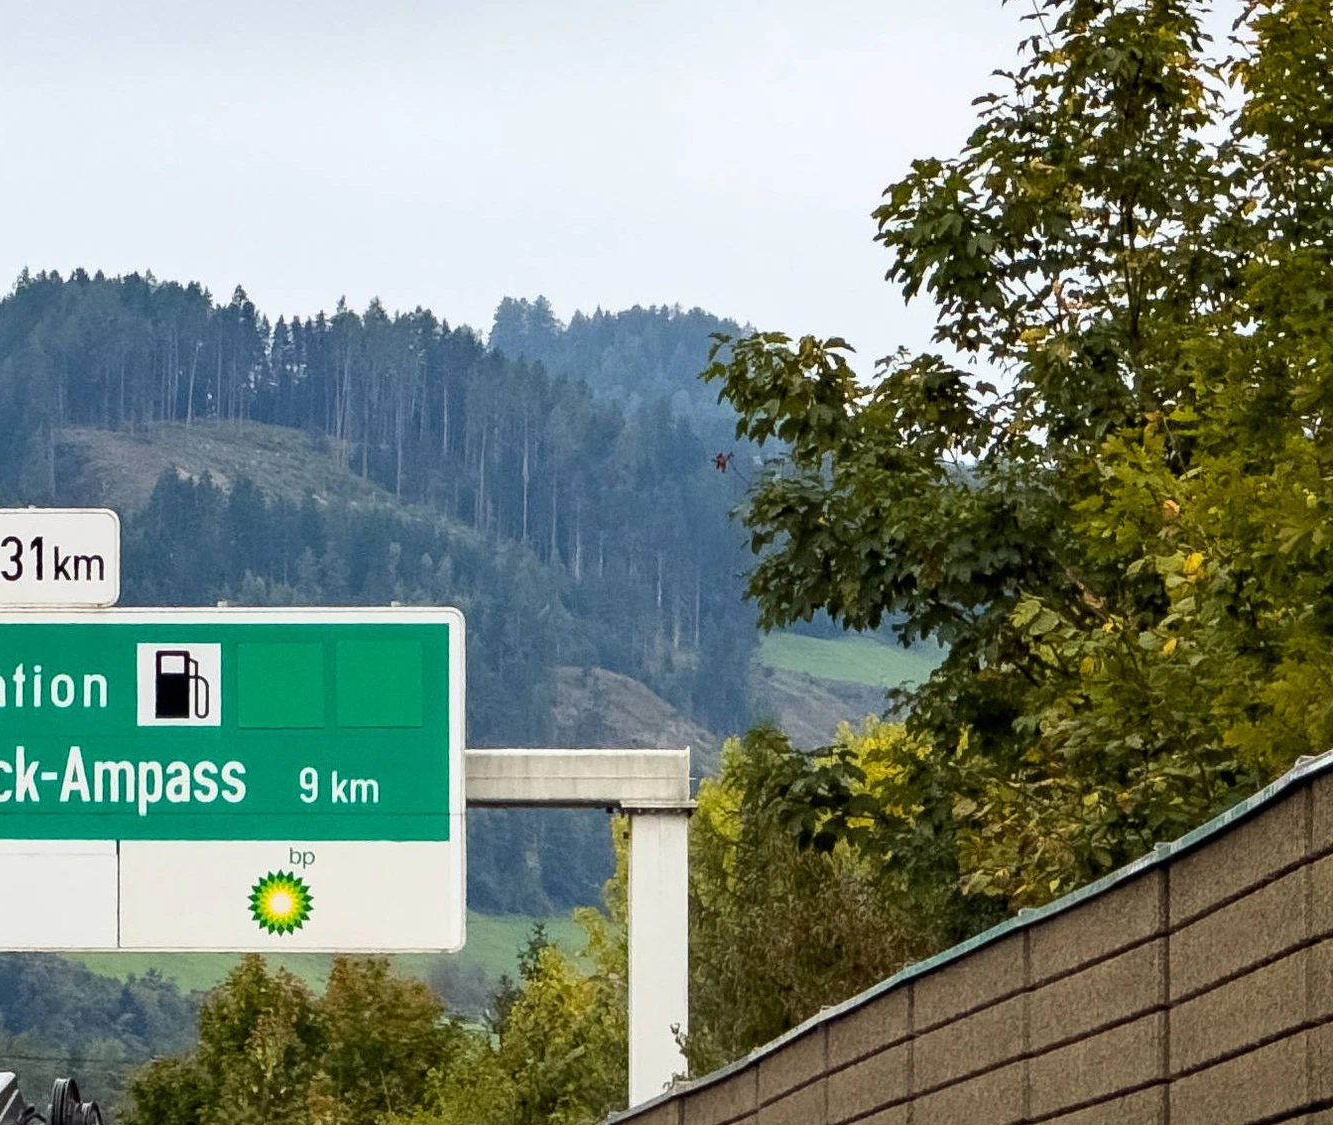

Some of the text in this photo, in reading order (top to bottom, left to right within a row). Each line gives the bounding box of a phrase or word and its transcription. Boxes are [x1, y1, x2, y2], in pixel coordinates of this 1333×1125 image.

[299, 767, 318, 803] 9
[331, 770, 379, 803] km
[289, 846, 316, 869] bp
